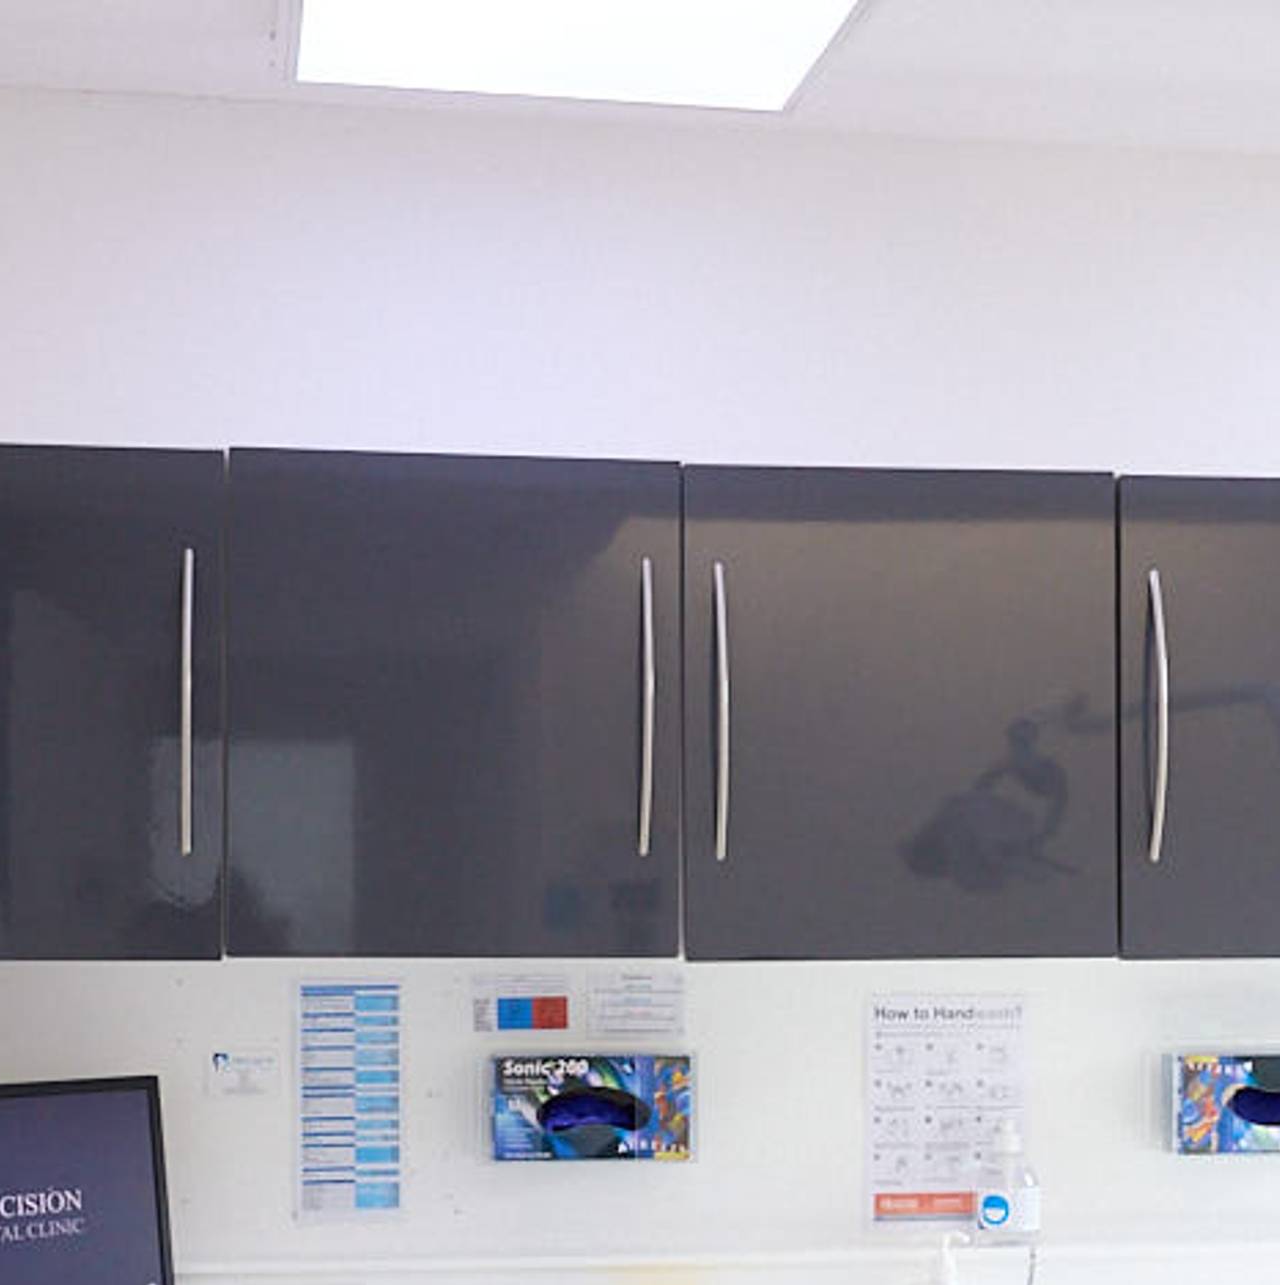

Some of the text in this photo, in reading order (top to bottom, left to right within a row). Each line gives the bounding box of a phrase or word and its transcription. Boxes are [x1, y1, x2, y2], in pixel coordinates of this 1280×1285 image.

[875, 1006, 909, 1020] How
[914, 1006, 930, 1020] to
[503, 1059, 553, 1076] Sonic
[26, 1217, 85, 1240] CLINIC
